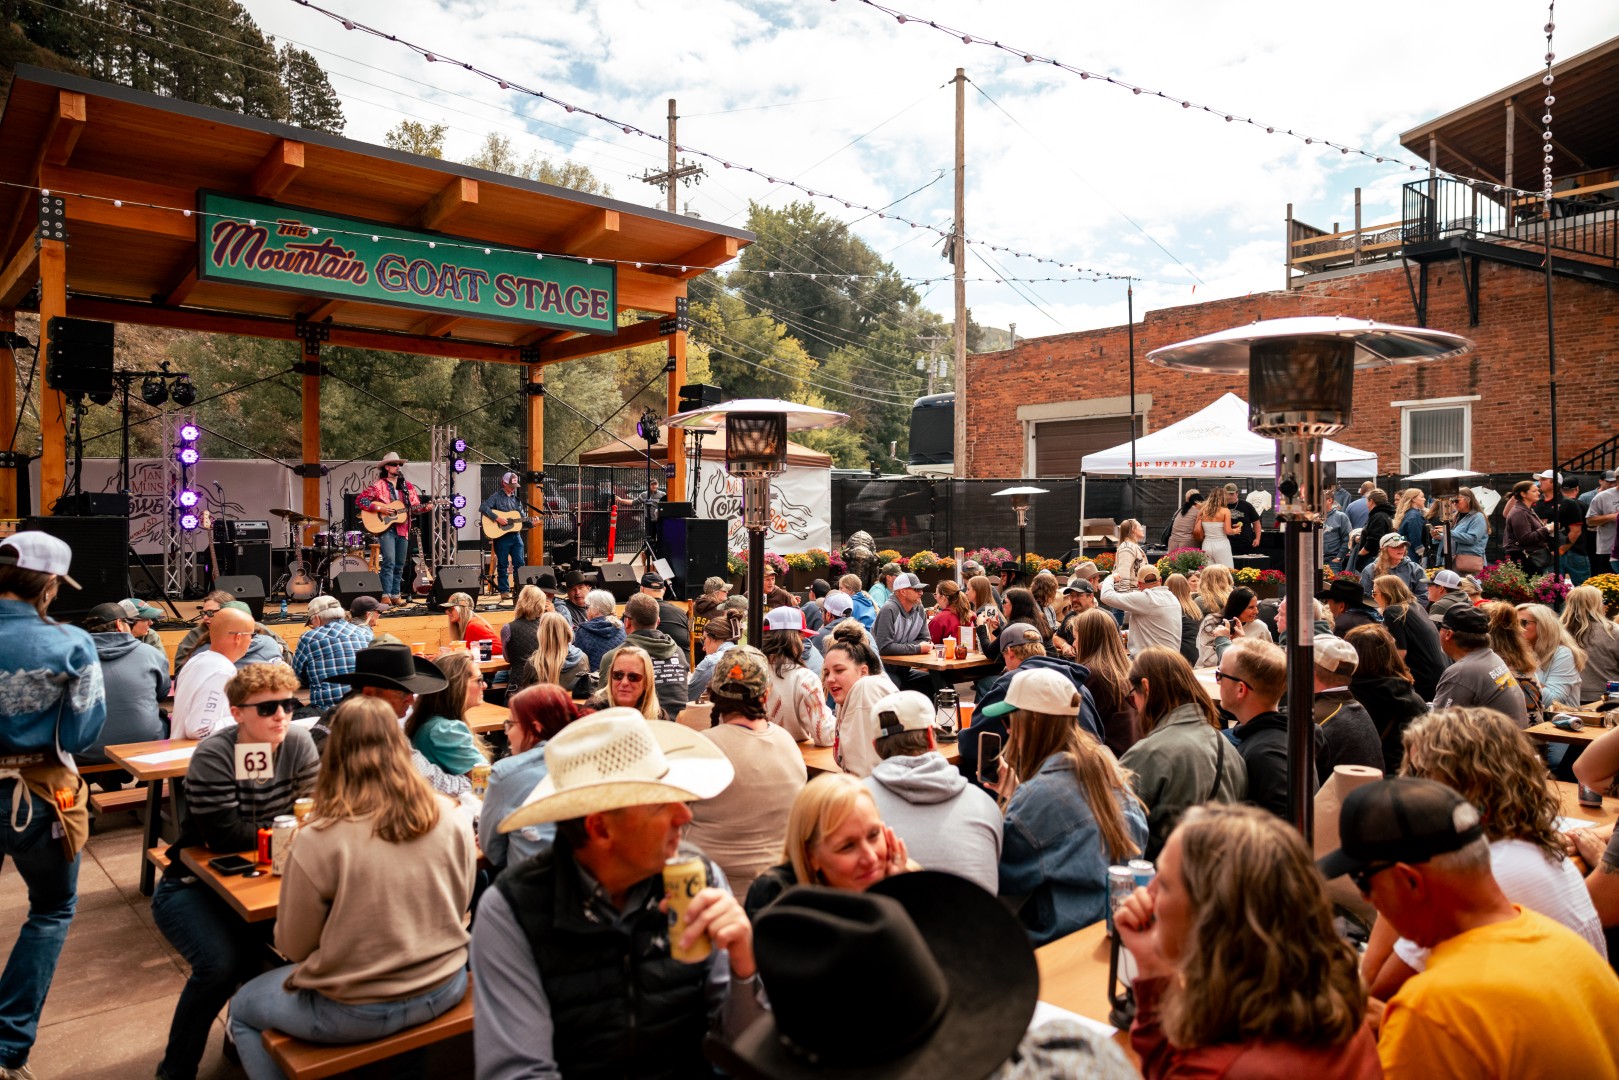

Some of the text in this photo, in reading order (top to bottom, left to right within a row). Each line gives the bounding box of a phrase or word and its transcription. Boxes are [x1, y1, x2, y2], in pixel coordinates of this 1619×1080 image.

[277, 219, 311, 238] THE
[212, 219, 609, 321] Mountain GOAT STAGE
[1155, 461, 1196, 469] HEARD
[1201, 460, 1235, 469] SHOP
[986, 609, 996, 618] 64
[204, 690, 220, 713] 1977
[244, 751, 268, 772] 63
